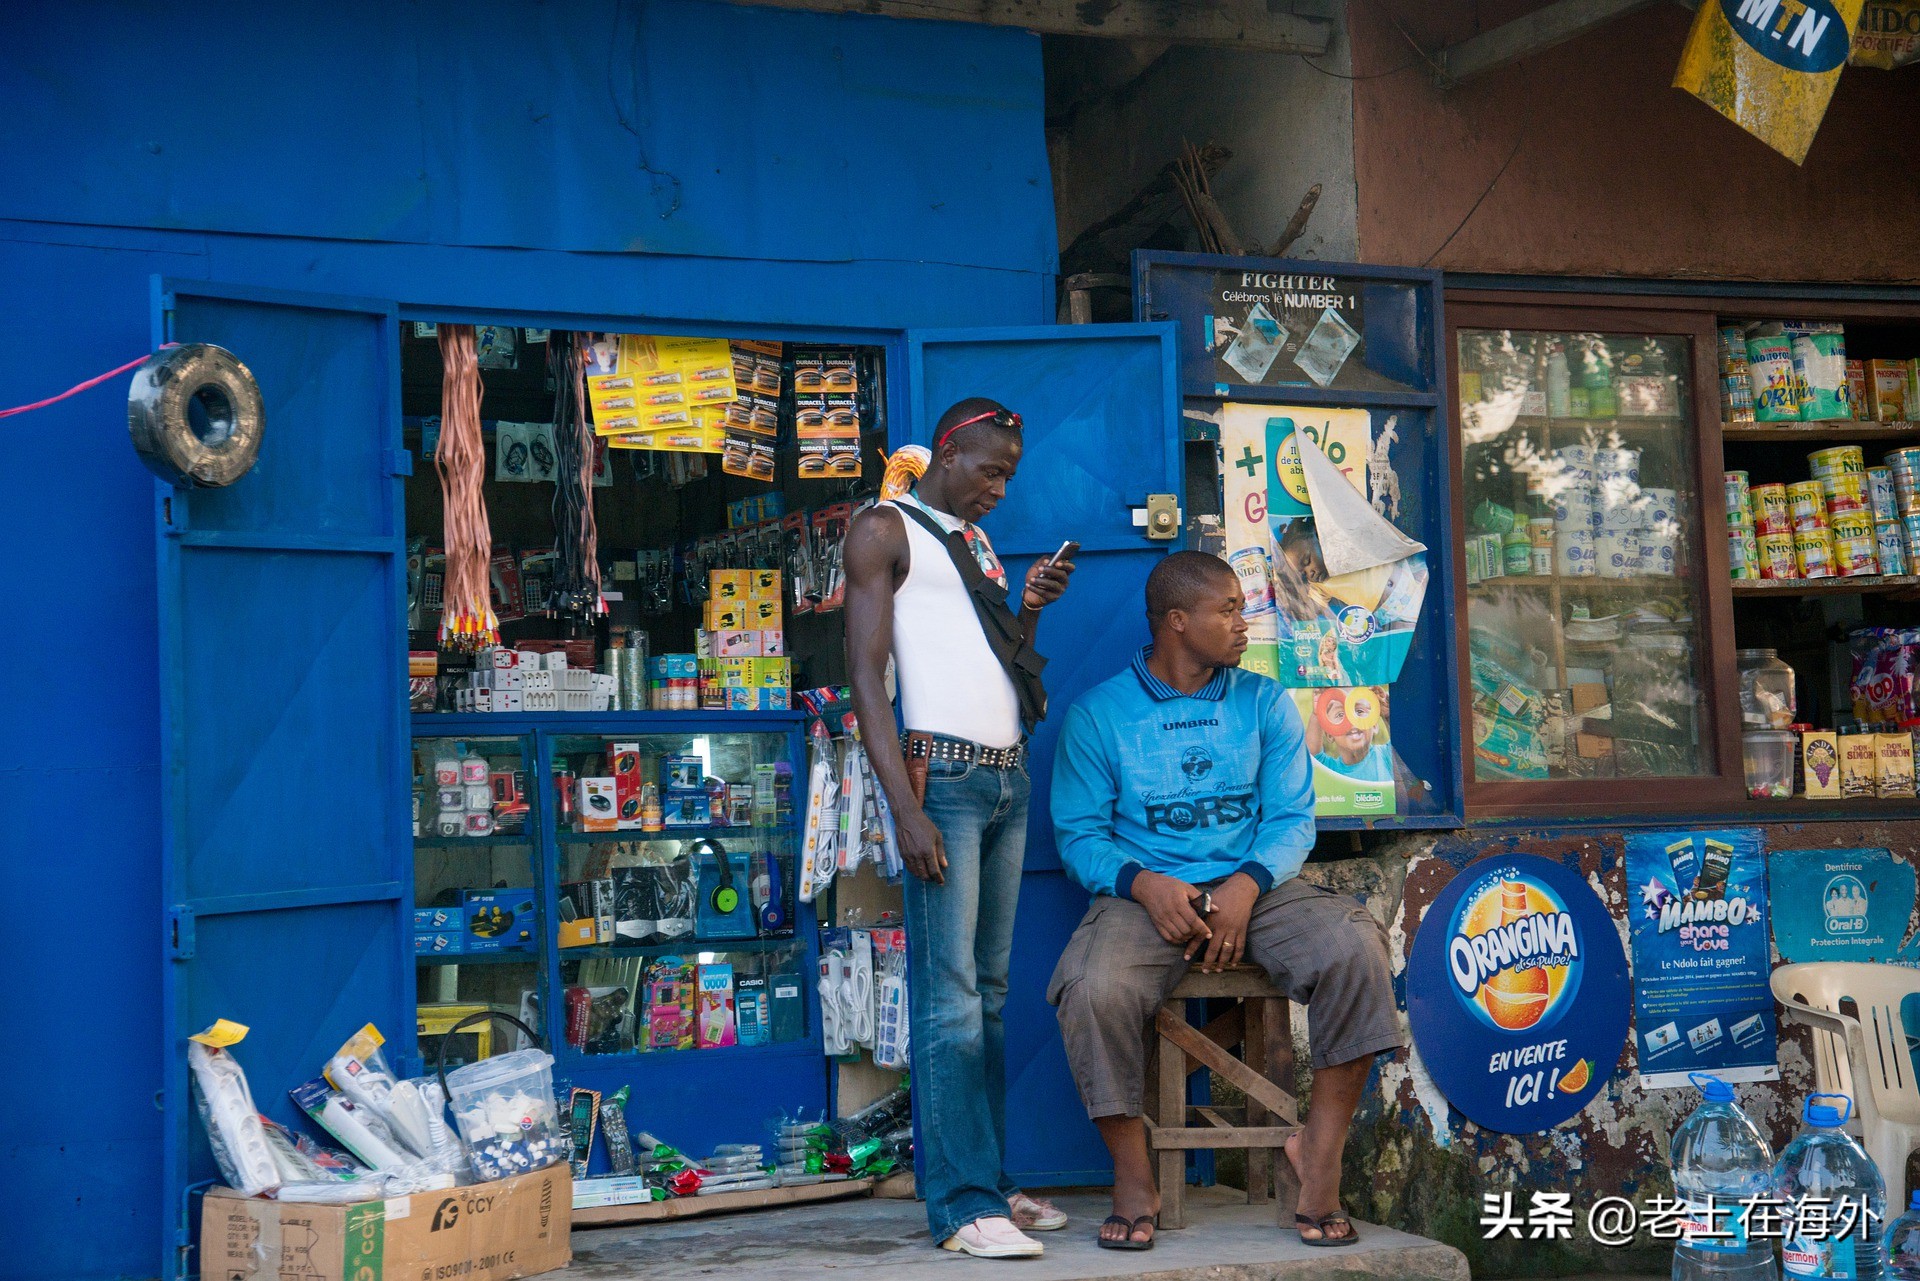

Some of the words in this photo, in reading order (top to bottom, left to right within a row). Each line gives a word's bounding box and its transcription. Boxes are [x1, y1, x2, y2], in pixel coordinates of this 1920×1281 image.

[1855, 36, 1913, 53] FORTIFIÉ
[1241, 272, 1336, 291] FIGHTER
[1222, 290, 1270, 303] Célébrons
[1284, 293, 1343, 309] NUMBER
[1348, 295, 1355, 309] 1
[756, 358, 780, 368] DURACELL
[737, 395, 752, 403] ACELL
[754, 398, 778, 408] DURACELL
[726, 438, 750, 448] DURACELL
[752, 443, 775, 453] DURACELL
[1281, 455, 1291, 465] de
[1834, 525, 1872, 540] NIDO
[1295, 630, 1322, 641] Pampers
[1866, 676, 1894, 703] top
[1162, 718, 1219, 731] UMBRO
[1847, 750, 1874, 760] SIMON
[1881, 748, 1911, 758] SIMON
[1145, 793, 1255, 833] FORST
[1673, 851, 1694, 868] MAMBO
[1706, 852, 1730, 865] MAMBO
[1824, 862, 1863, 872] Dentifrice
[1658, 897, 1747, 934] MAMBO
[1680, 922, 1729, 939] share
[1680, 939, 1695, 947] your
[1810, 938, 1850, 947] Protection
[1851, 935, 1885, 946] Integrale
[1450, 912, 1578, 993] ORANGINA
[1537, 954, 1571, 970] pulpe!
[1661, 961, 1671, 970] Le
[1673, 960, 1699, 969] Ndolo
[1700, 957, 1714, 968] fait
[1715, 955, 1747, 968] gagner!
[739, 979, 764, 987] CASIO
[1489, 1049, 1513, 1074] EN
[1514, 1039, 1568, 1068] VENTE
[1505, 1070, 1545, 1109] ICI
[466, 1195, 496, 1215] CCY
[479, 1257, 501, 1271] 2001
